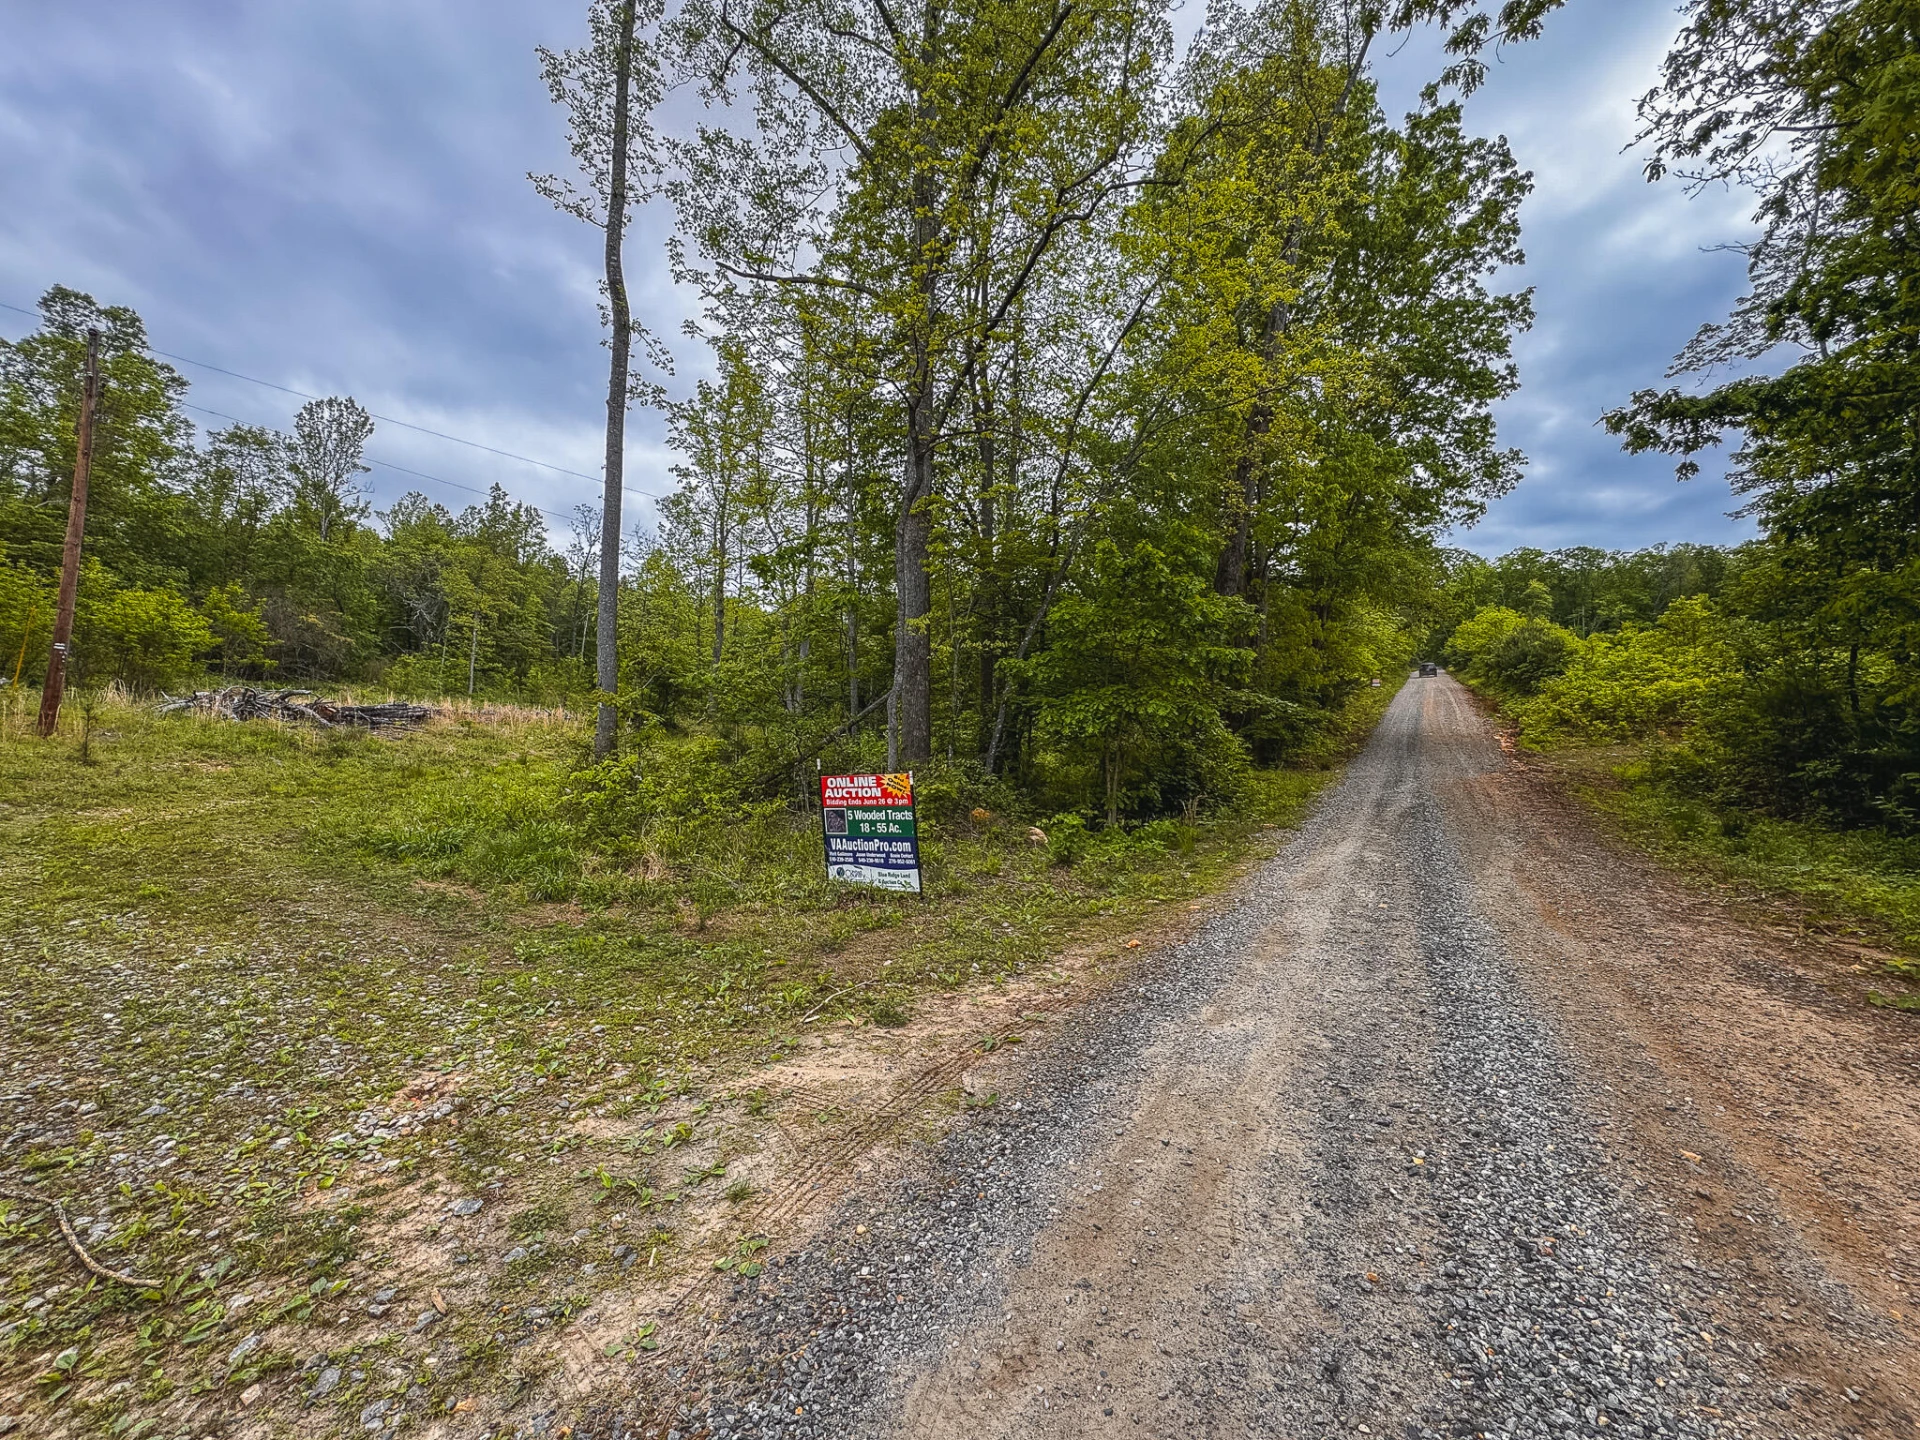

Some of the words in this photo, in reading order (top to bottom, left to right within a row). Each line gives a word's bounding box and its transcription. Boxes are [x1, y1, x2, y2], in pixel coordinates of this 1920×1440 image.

[827, 776, 877, 788] ONLINE
[824, 787, 882, 798] AUCTION
[826, 798, 847, 806] Bidding
[894, 798, 908, 806] 3pm
[847, 810, 853, 820] 5
[853, 810, 886, 820] Wooded
[886, 809, 913, 820] Tracts
[859, 822, 870, 833] 18
[877, 822, 887, 833] 55
[888, 822, 902, 833] Ac.
[830, 838, 912, 852] VAAuctionPro.com
